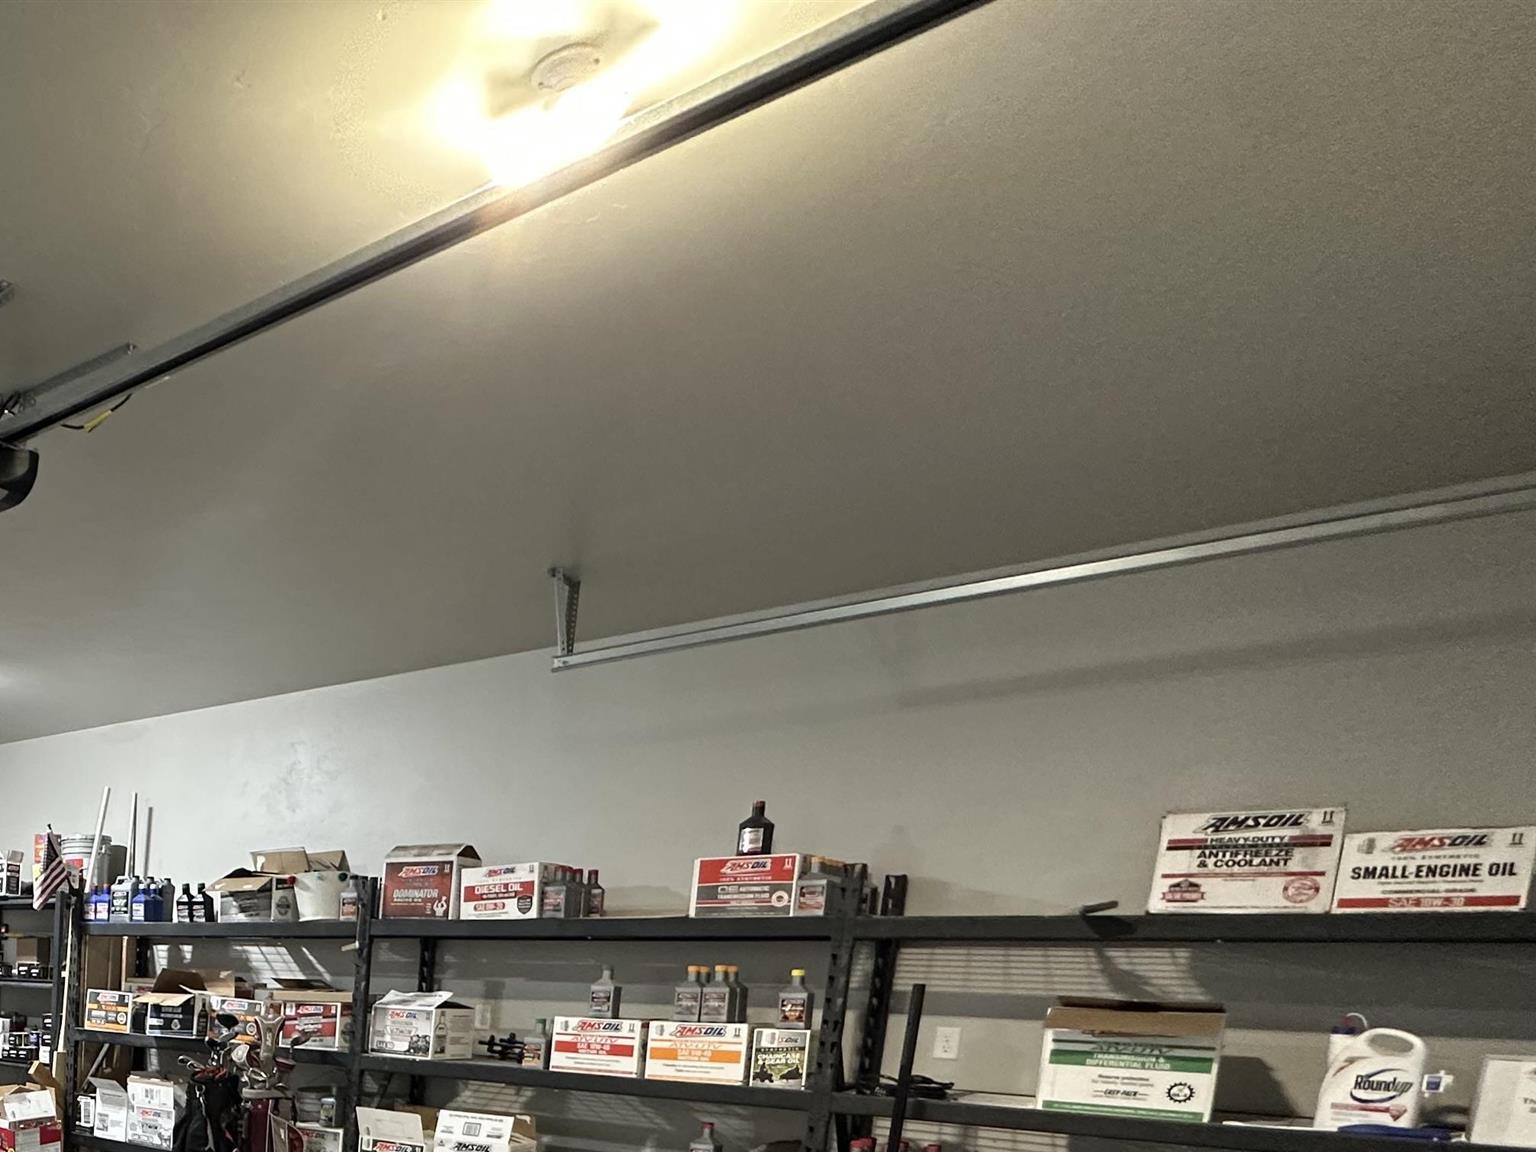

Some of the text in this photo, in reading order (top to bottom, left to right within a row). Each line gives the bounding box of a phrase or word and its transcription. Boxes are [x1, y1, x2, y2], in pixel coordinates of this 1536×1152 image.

[1199, 814, 1307, 833] AMSOIL
[1209, 835, 1286, 844] HEAVY-DUTY
[1391, 834, 1488, 852] AMSOIL
[1197, 848, 1294, 859] ANTIFREEZE
[725, 860, 769, 872] AMSOIL
[1197, 857, 1291, 868] & COOLANT
[399, 865, 438, 877] AMSOIL
[1350, 861, 1518, 880] SMALL-ENGINE OIL
[392, 889, 439, 898] DOMINATOR
[475, 882, 523, 894] DIESEL OIL
[577, 1021, 622, 1031] AMSOIL
[676, 1024, 725, 1037] AMSOIL
[1085, 1059, 1171, 1070] DIFFERENTIAL FLUID
[1353, 1075, 1413, 1096] Roundup
[452, 1142, 491, 1152] AMSOIL
